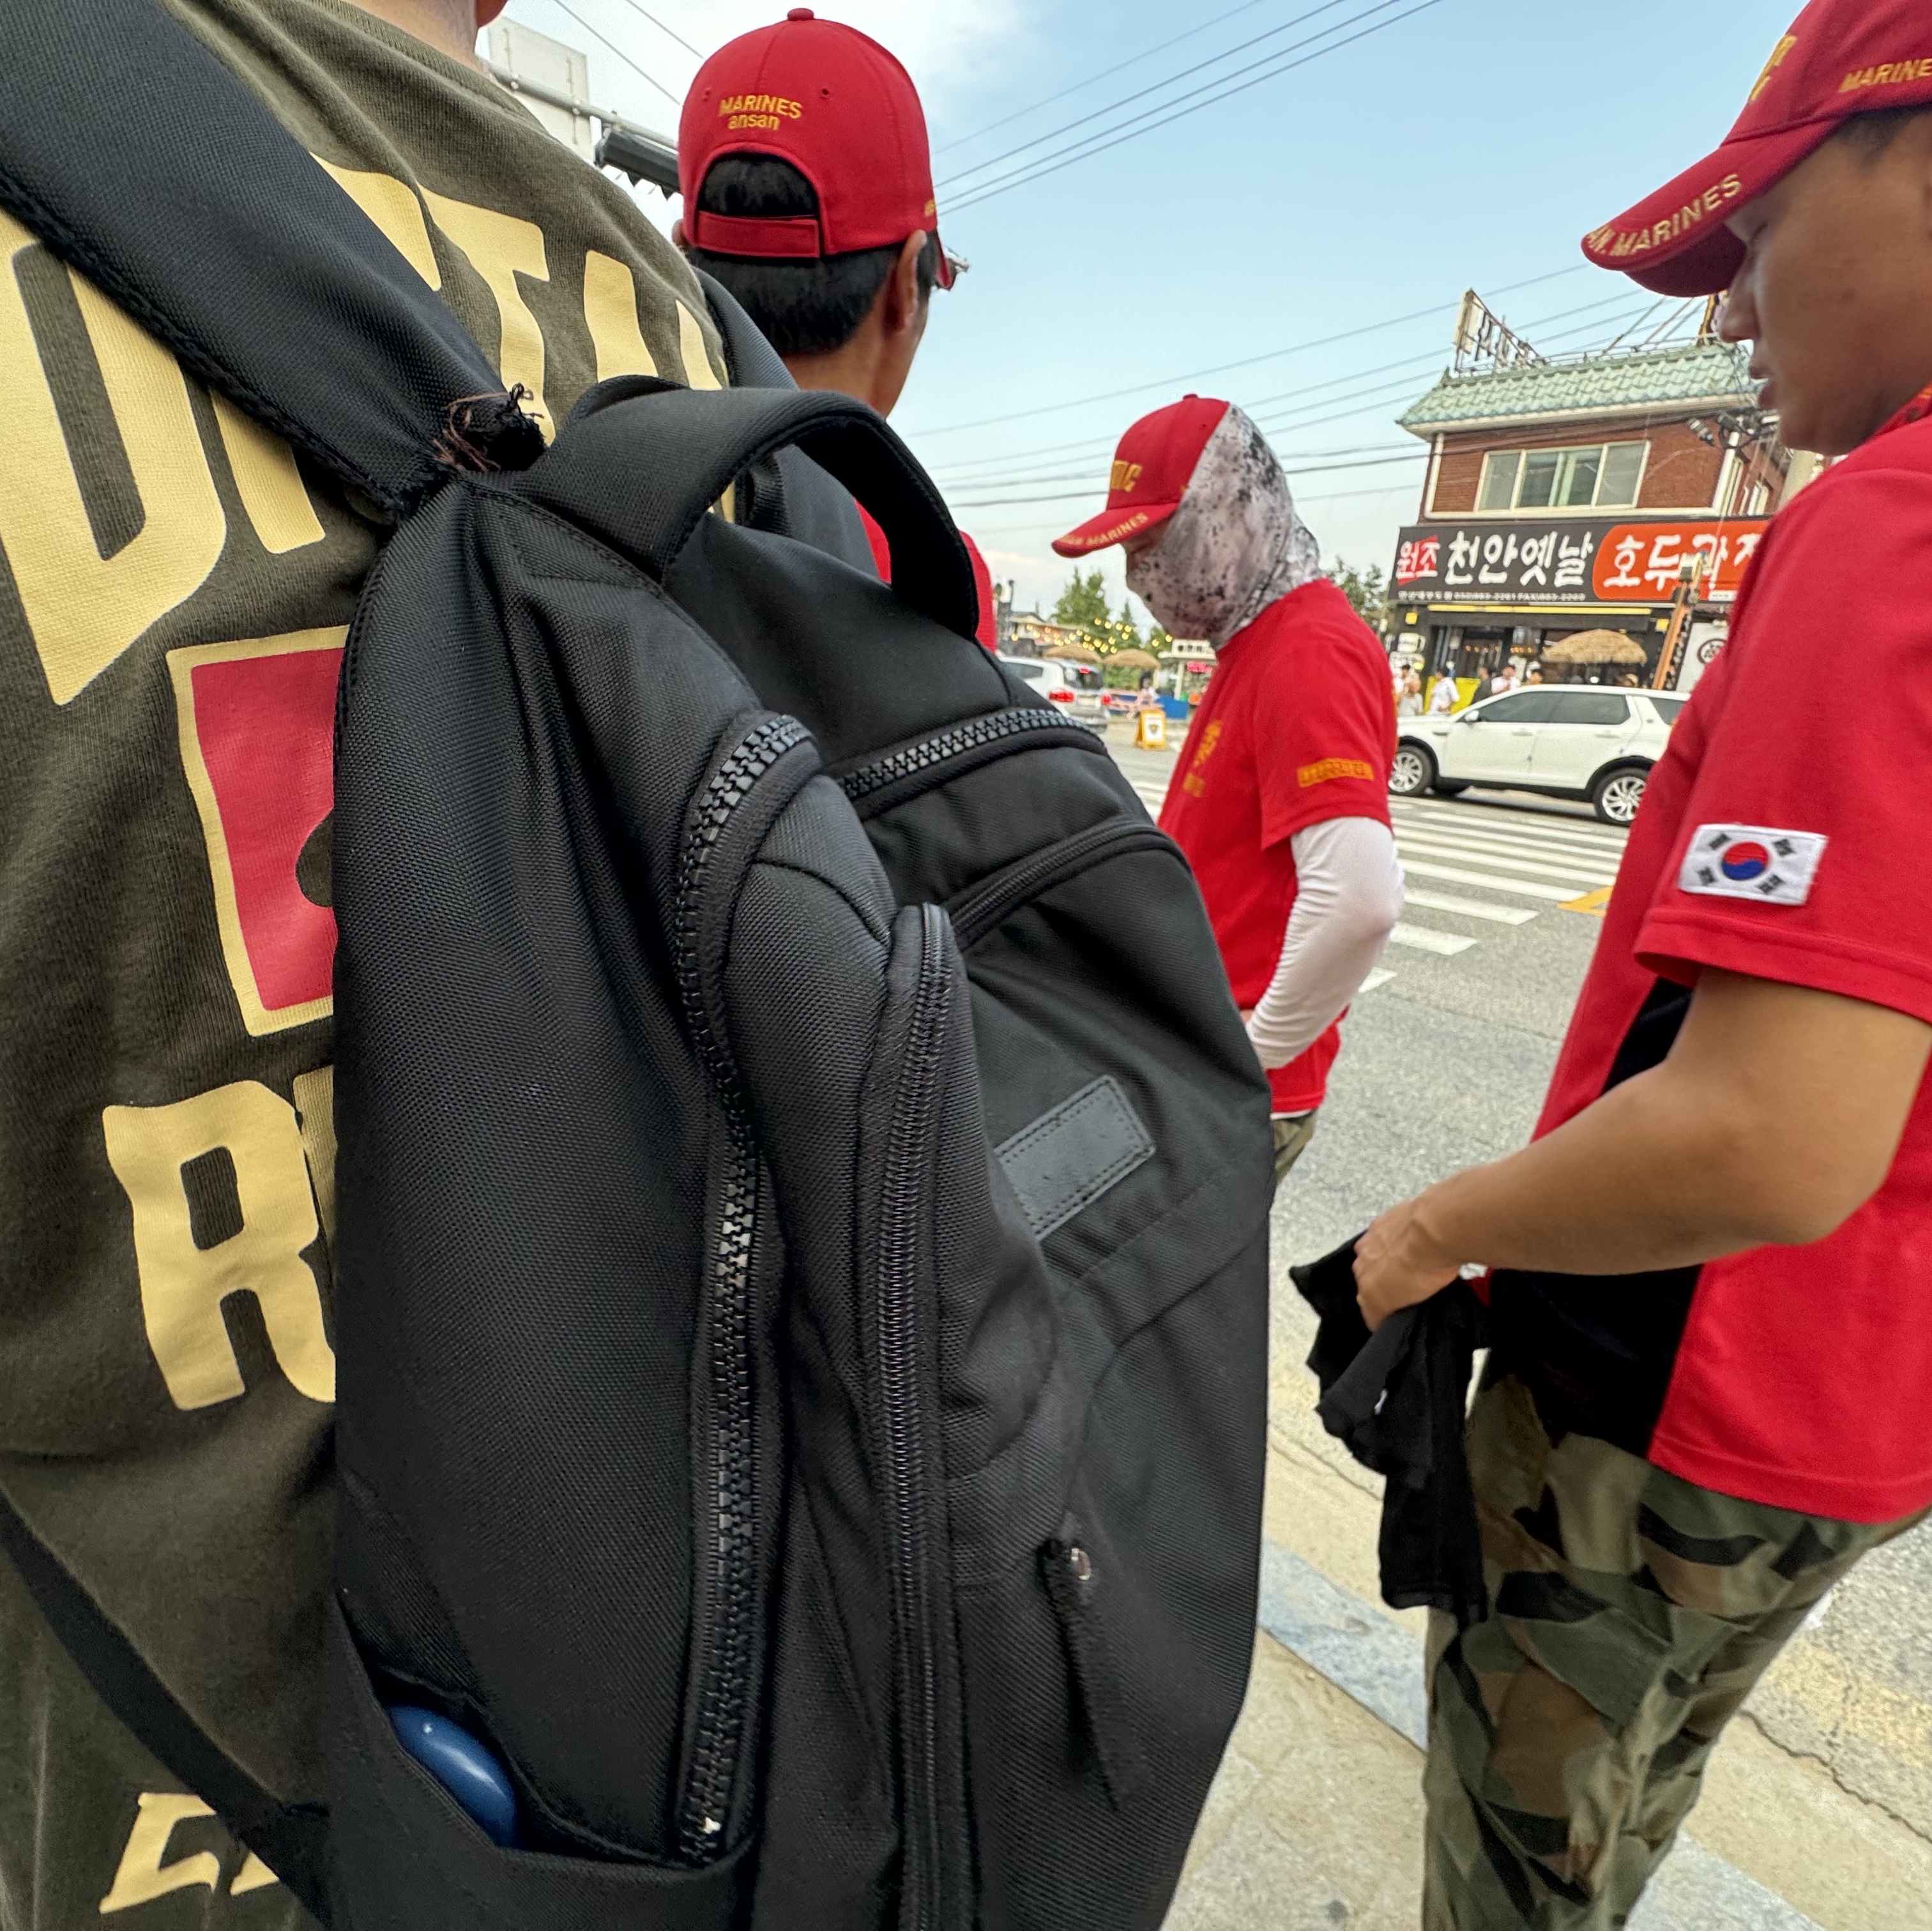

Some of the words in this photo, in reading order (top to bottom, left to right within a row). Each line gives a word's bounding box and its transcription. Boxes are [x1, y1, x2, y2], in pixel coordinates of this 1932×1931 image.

[719, 95, 803, 119] MARINES
[728, 114, 780, 131] ansan
[1609, 173, 1742, 257] MARINES
[1085, 512, 1149, 546] MARINES
[1396, 541, 1440, 579] 원조
[1445, 531, 1594, 587] 천안옛날
